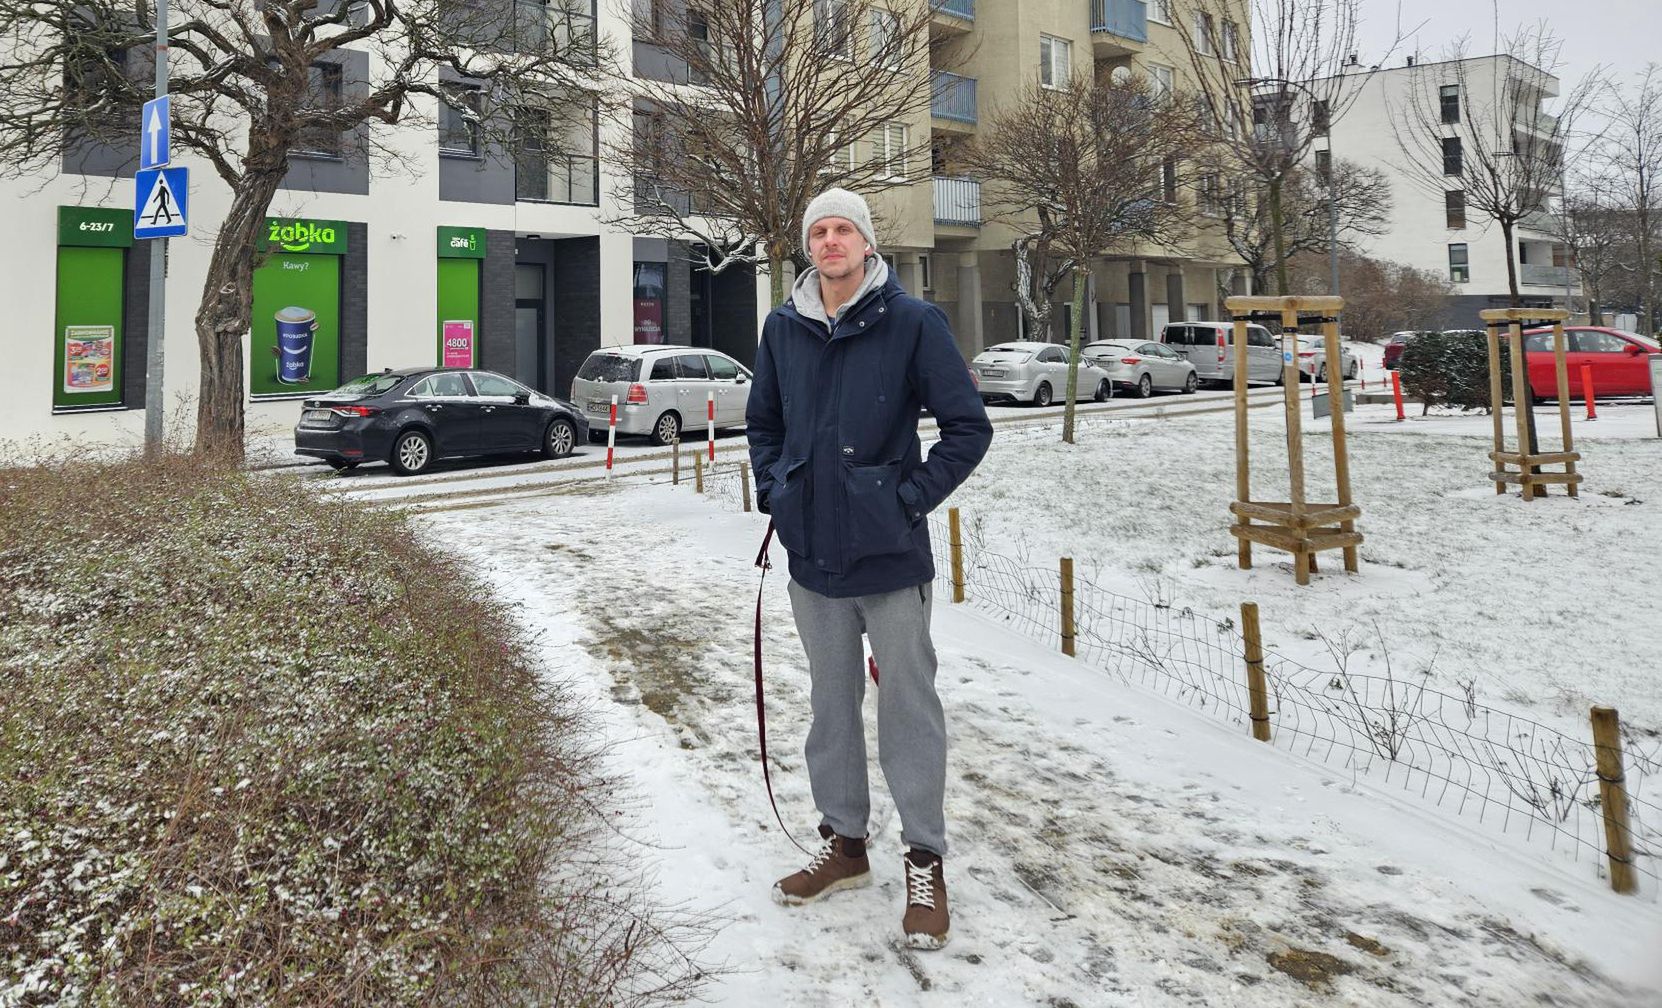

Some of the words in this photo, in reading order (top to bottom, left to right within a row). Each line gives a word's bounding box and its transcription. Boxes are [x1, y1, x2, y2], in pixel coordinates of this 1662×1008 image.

[79, 222, 114, 232] 6-23/7
[268, 221, 335, 244] żabka
[450, 238, 469, 248] café
[283, 261, 310, 272] Kawy?
[446, 338, 468, 348] 4800
